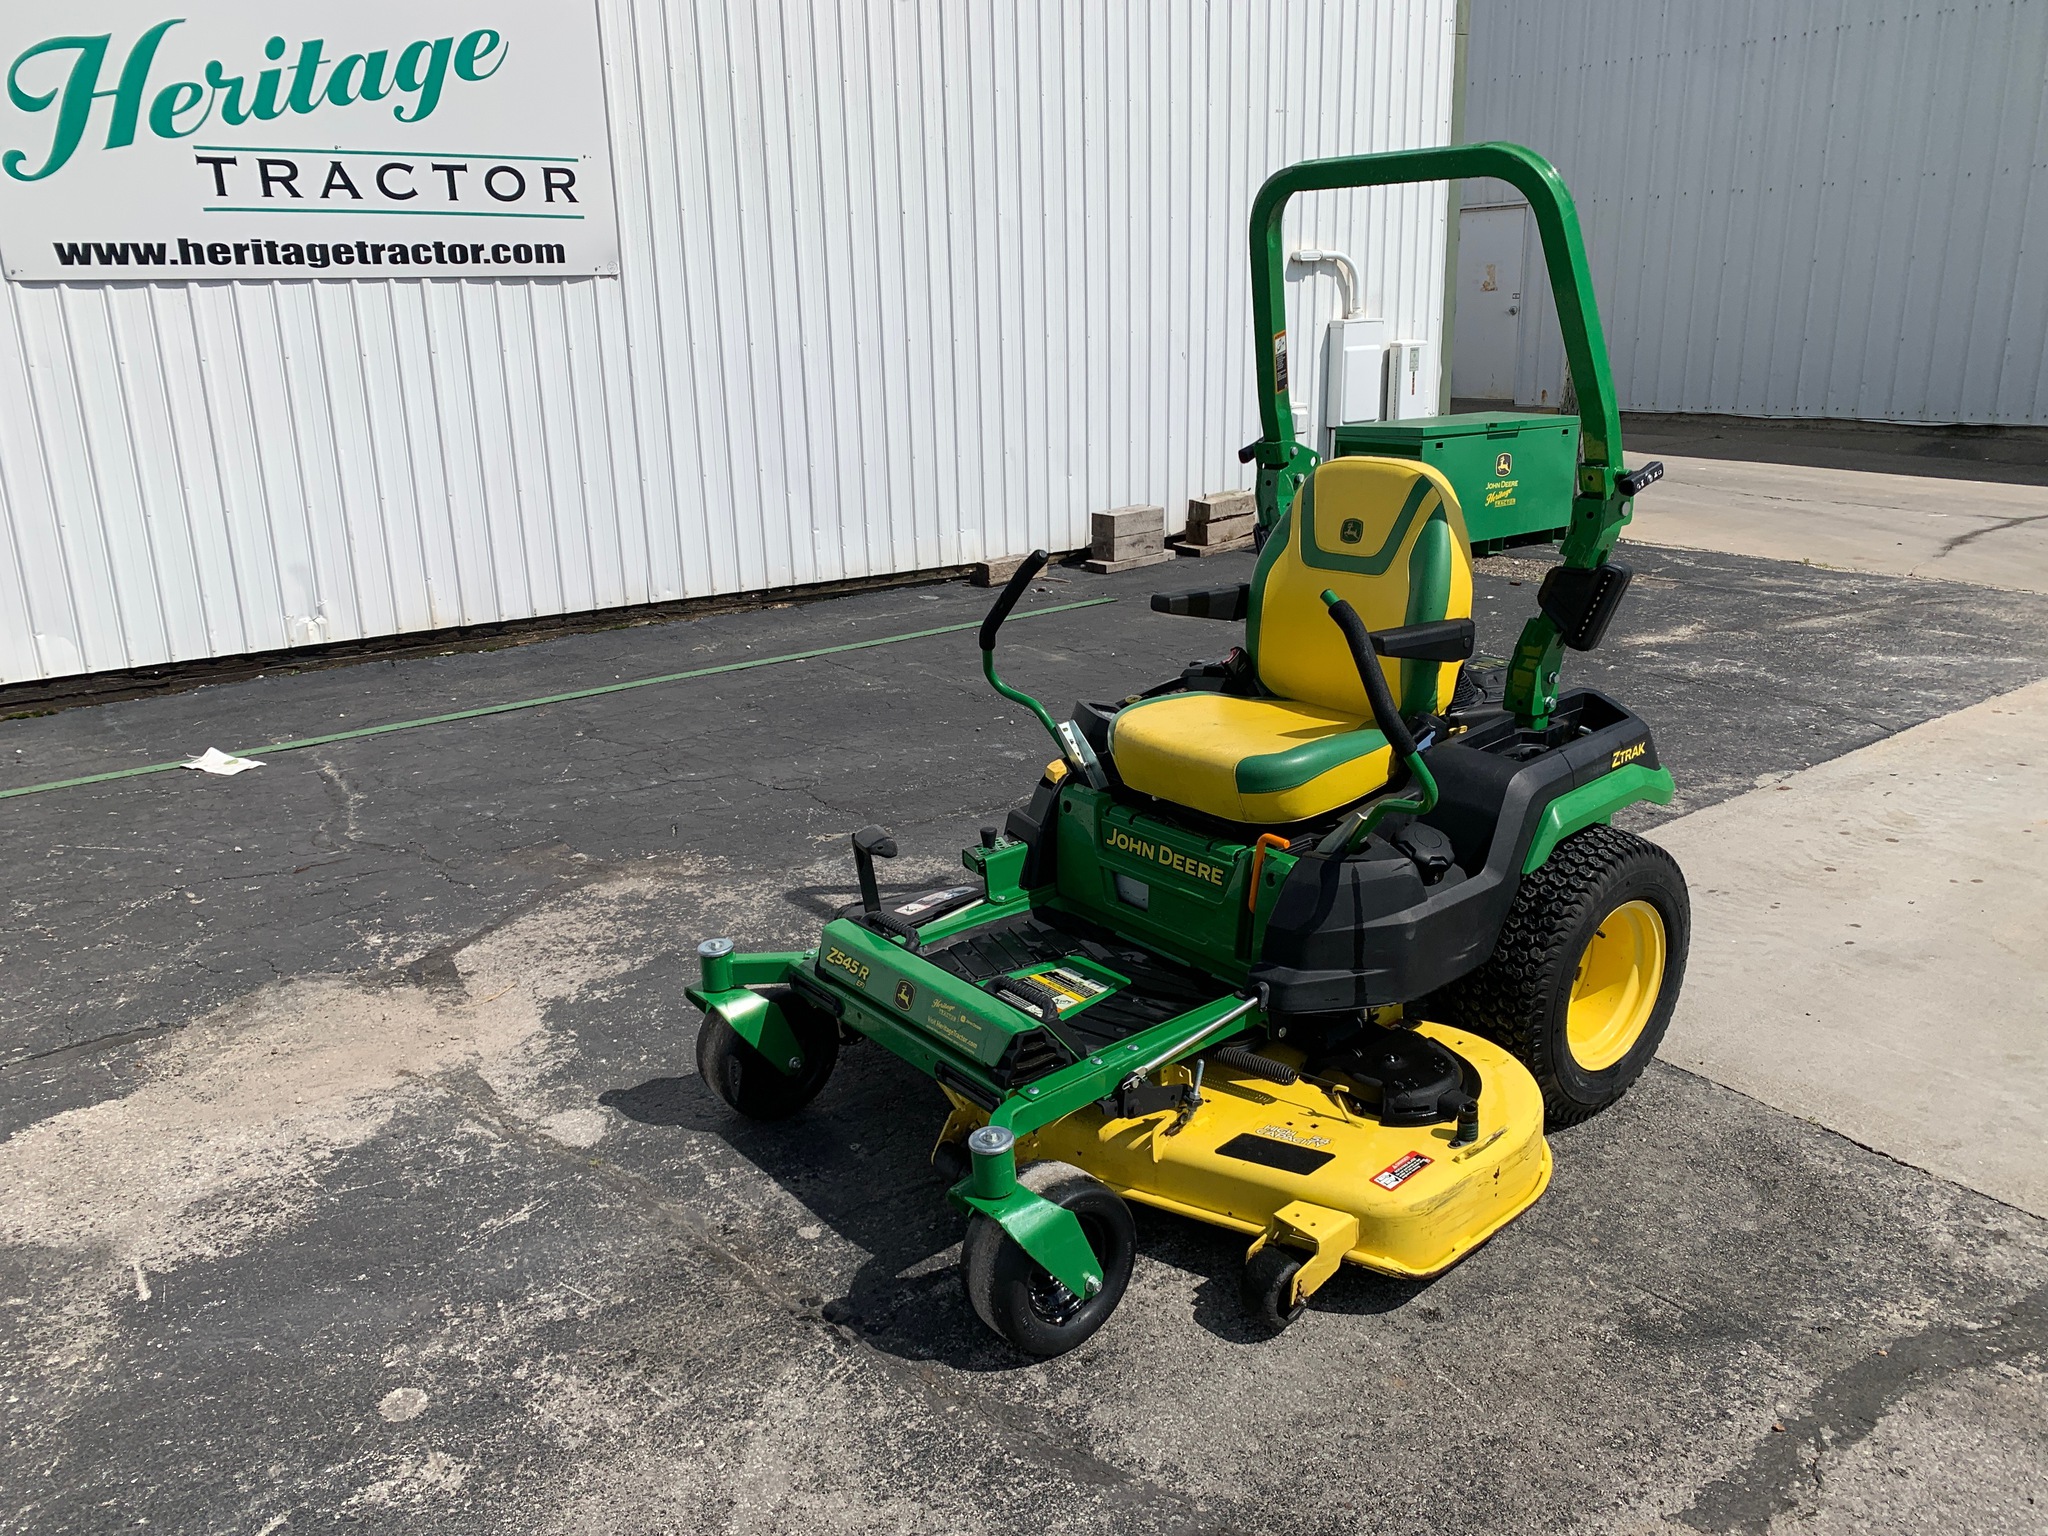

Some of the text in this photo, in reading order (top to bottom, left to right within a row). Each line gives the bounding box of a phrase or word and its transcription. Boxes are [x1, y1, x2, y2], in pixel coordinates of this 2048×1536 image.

[2, 18, 509, 182] Heritage
[196, 155, 579, 203] TRACTOR
[52, 237, 566, 269] www.heritagetractor.com
[1612, 741, 1646, 768] ZTRAK
[1106, 828, 1224, 886] JOHN DEERE
[826, 947, 870, 980] Z545 R
[1255, 1128, 1323, 1148] CAPACITY
[1263, 1124, 1298, 1137] HIGH
